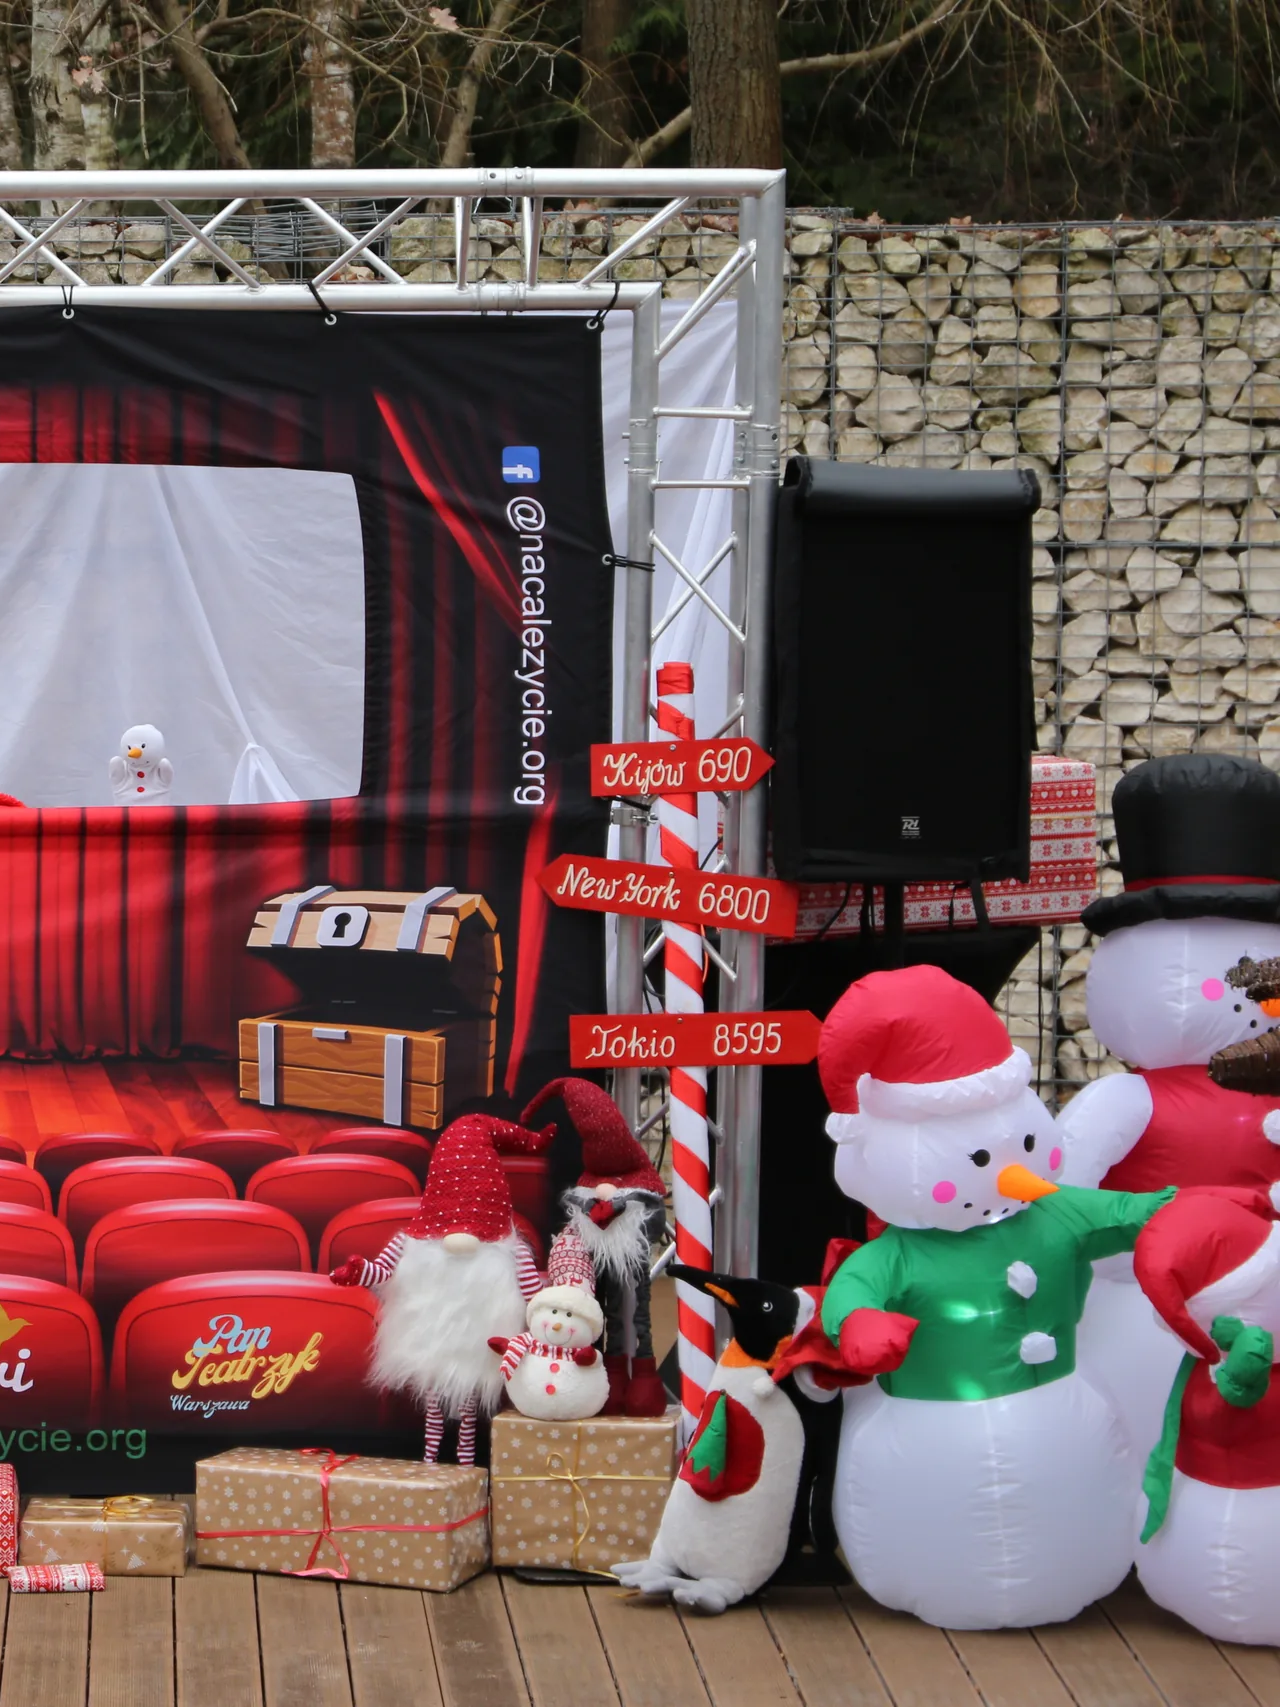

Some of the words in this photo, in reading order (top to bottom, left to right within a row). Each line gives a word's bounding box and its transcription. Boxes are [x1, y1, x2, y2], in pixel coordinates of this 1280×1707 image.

[505, 496, 553, 805] @nacalezycie.org
[603, 752, 686, 794] Kijów
[698, 746, 752, 783] 690
[556, 863, 623, 899] New
[618, 872, 681, 911] York
[698, 882, 771, 924] 6800
[585, 1024, 676, 1059] Tokio
[713, 1022, 782, 1056] 8595
[192, 1314, 271, 1358] Pan
[171, 1332, 324, 1400] Teatrzyk
[170, 1395, 250, 1419] Warszawa
